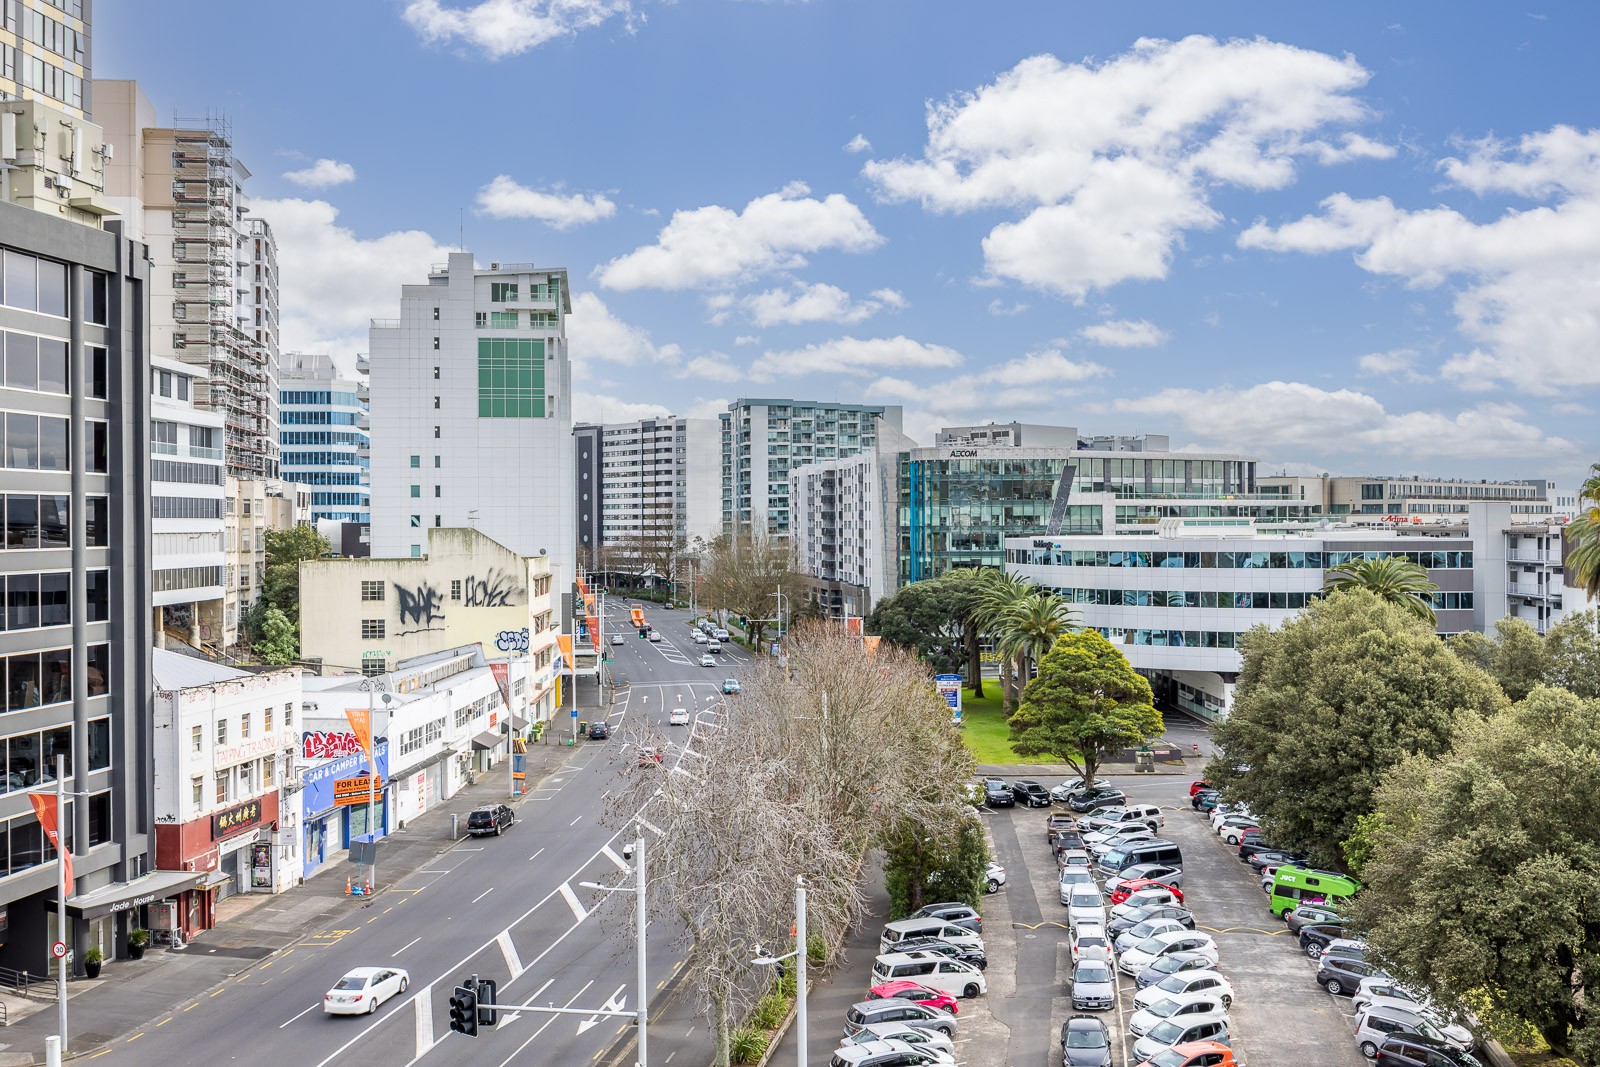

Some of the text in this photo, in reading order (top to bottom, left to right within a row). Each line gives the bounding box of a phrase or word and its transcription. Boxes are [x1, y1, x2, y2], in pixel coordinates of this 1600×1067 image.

[308, 771, 323, 784] CAR
[324, 767, 329, 777] &
[331, 755, 358, 774] CAMPER
[1280, 874, 1296, 882] JUCY
[110, 894, 155, 912] Jade House
